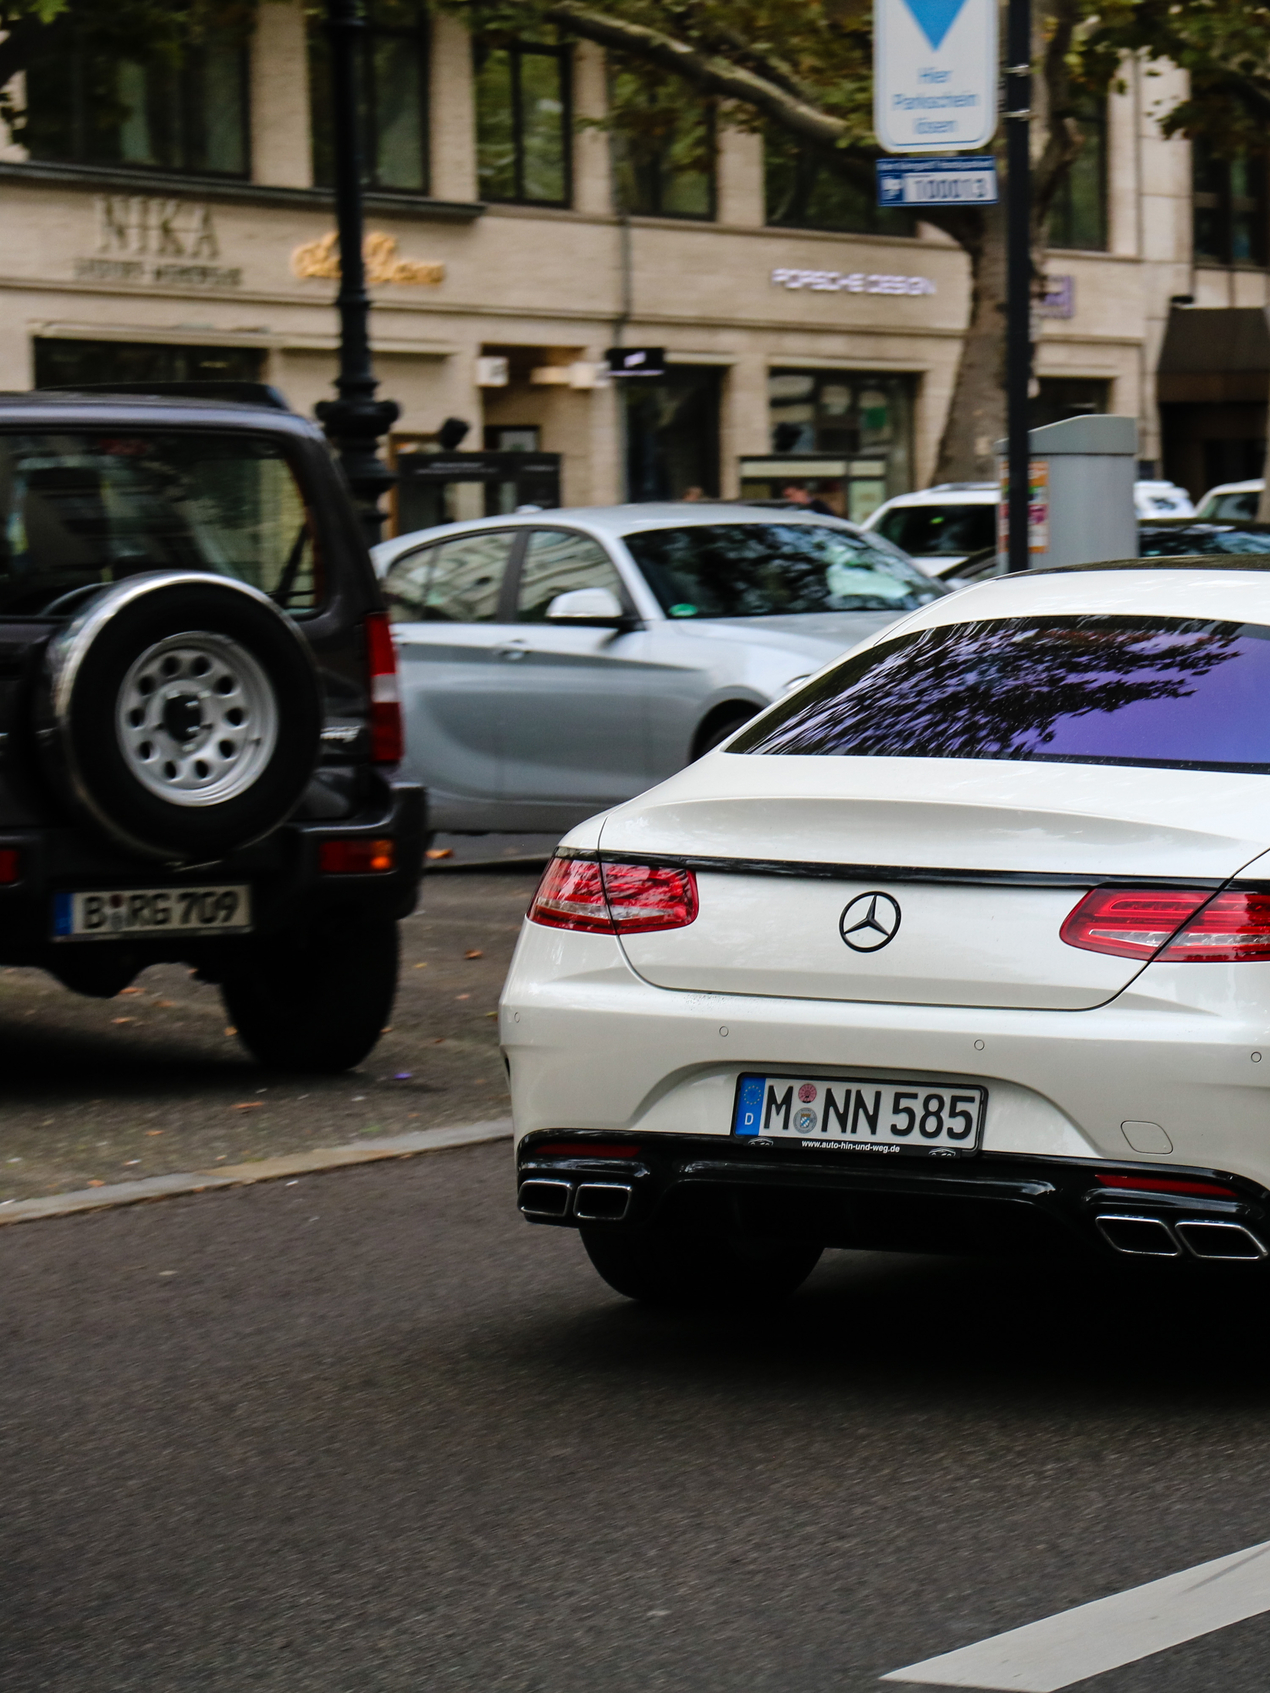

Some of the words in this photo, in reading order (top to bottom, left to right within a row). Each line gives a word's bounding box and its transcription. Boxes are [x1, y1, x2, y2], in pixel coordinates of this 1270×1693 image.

[771, 268, 865, 293] PORSCHE
[84, 896, 105, 930] B
[175, 890, 239, 925] 709
[744, 1112, 755, 1126] D
[763, 1085, 794, 1131] M
[821, 1088, 882, 1136] NN
[890, 1092, 976, 1140] 585
[801, 1139, 901, 1154] www.auto-hin-und-weg.de
